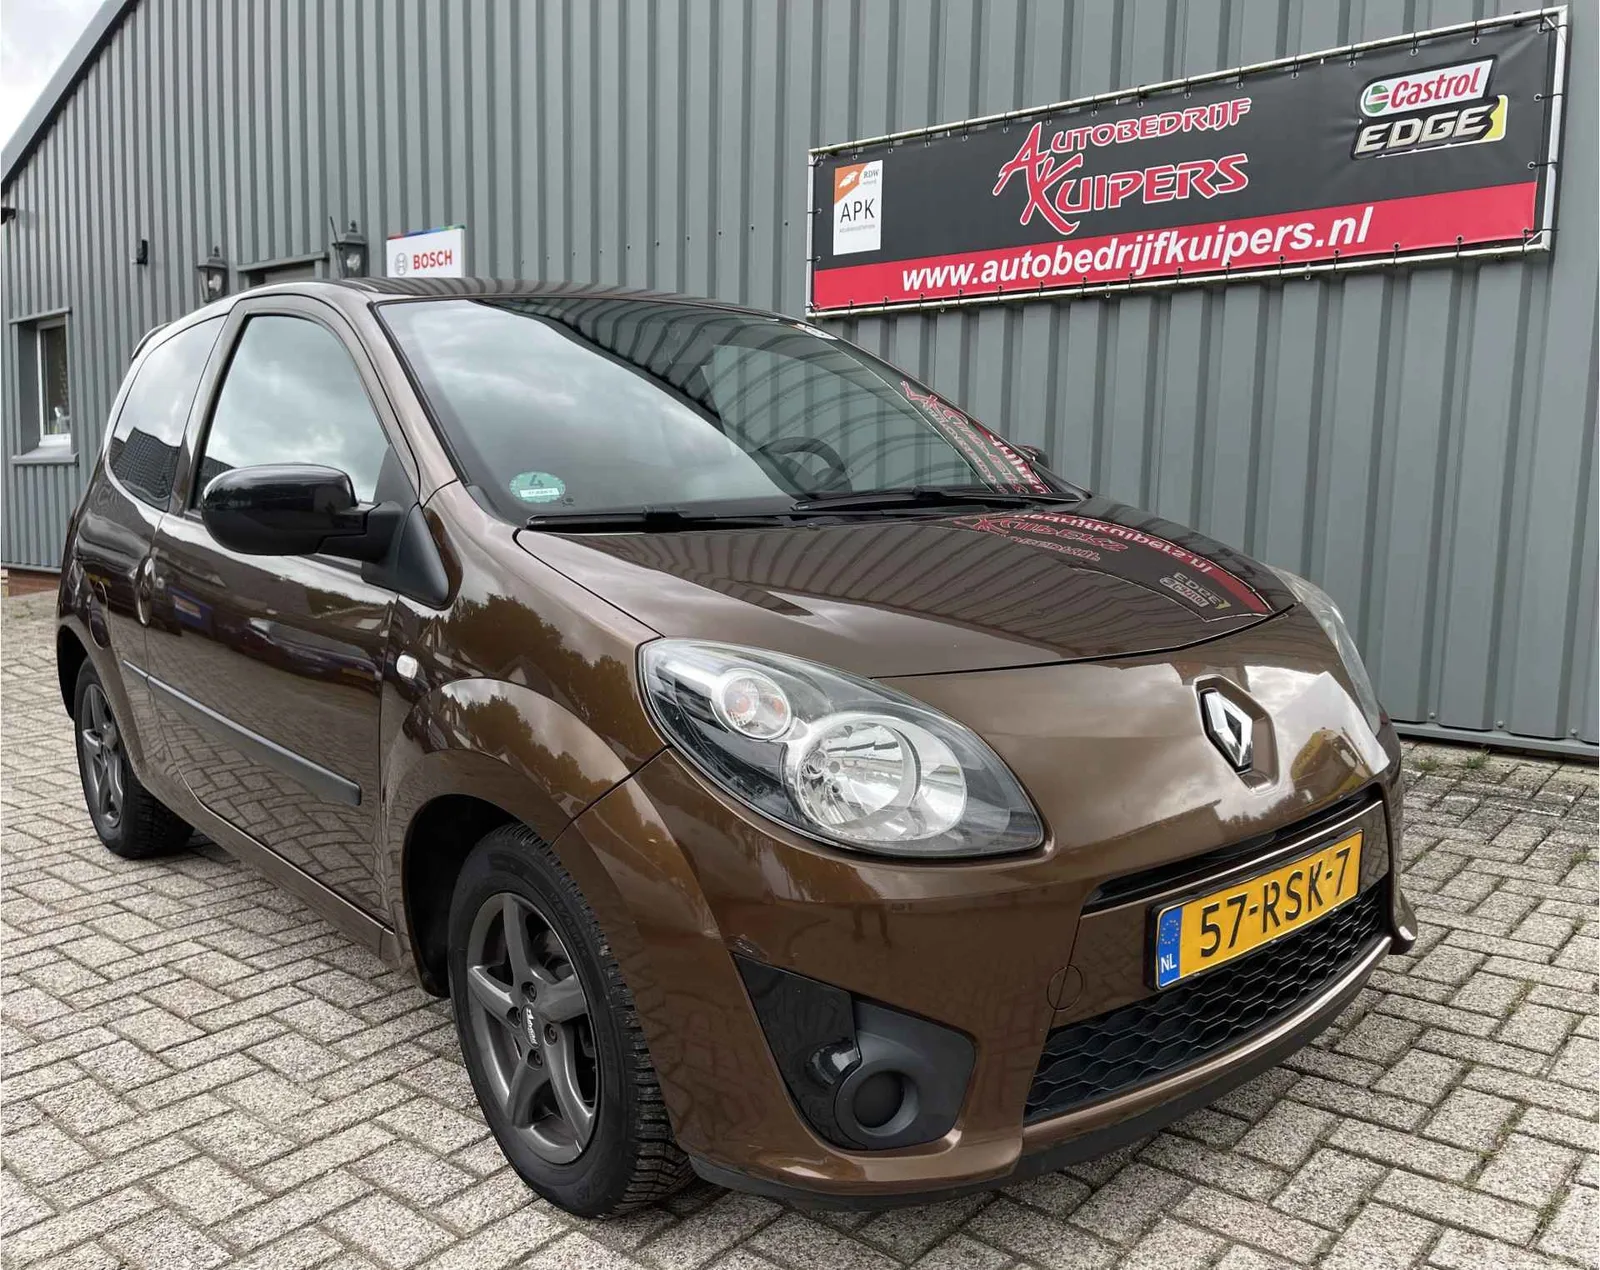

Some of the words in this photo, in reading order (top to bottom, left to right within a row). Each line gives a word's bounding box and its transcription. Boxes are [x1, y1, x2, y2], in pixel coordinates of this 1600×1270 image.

[1391, 67, 1481, 109] Castrol
[992, 98, 1251, 196] AUTOBEDRIJF
[1354, 104, 1494, 155] EDGE
[840, 198, 875, 223] APK
[1020, 153, 1249, 235] KUIPERS
[413, 249, 452, 270] BOSCH
[902, 206, 1375, 291] www.autobedrijfkuipers.nl
[1200, 847, 1352, 959] 57-RSK-7
[1160, 955, 1177, 973] NL
